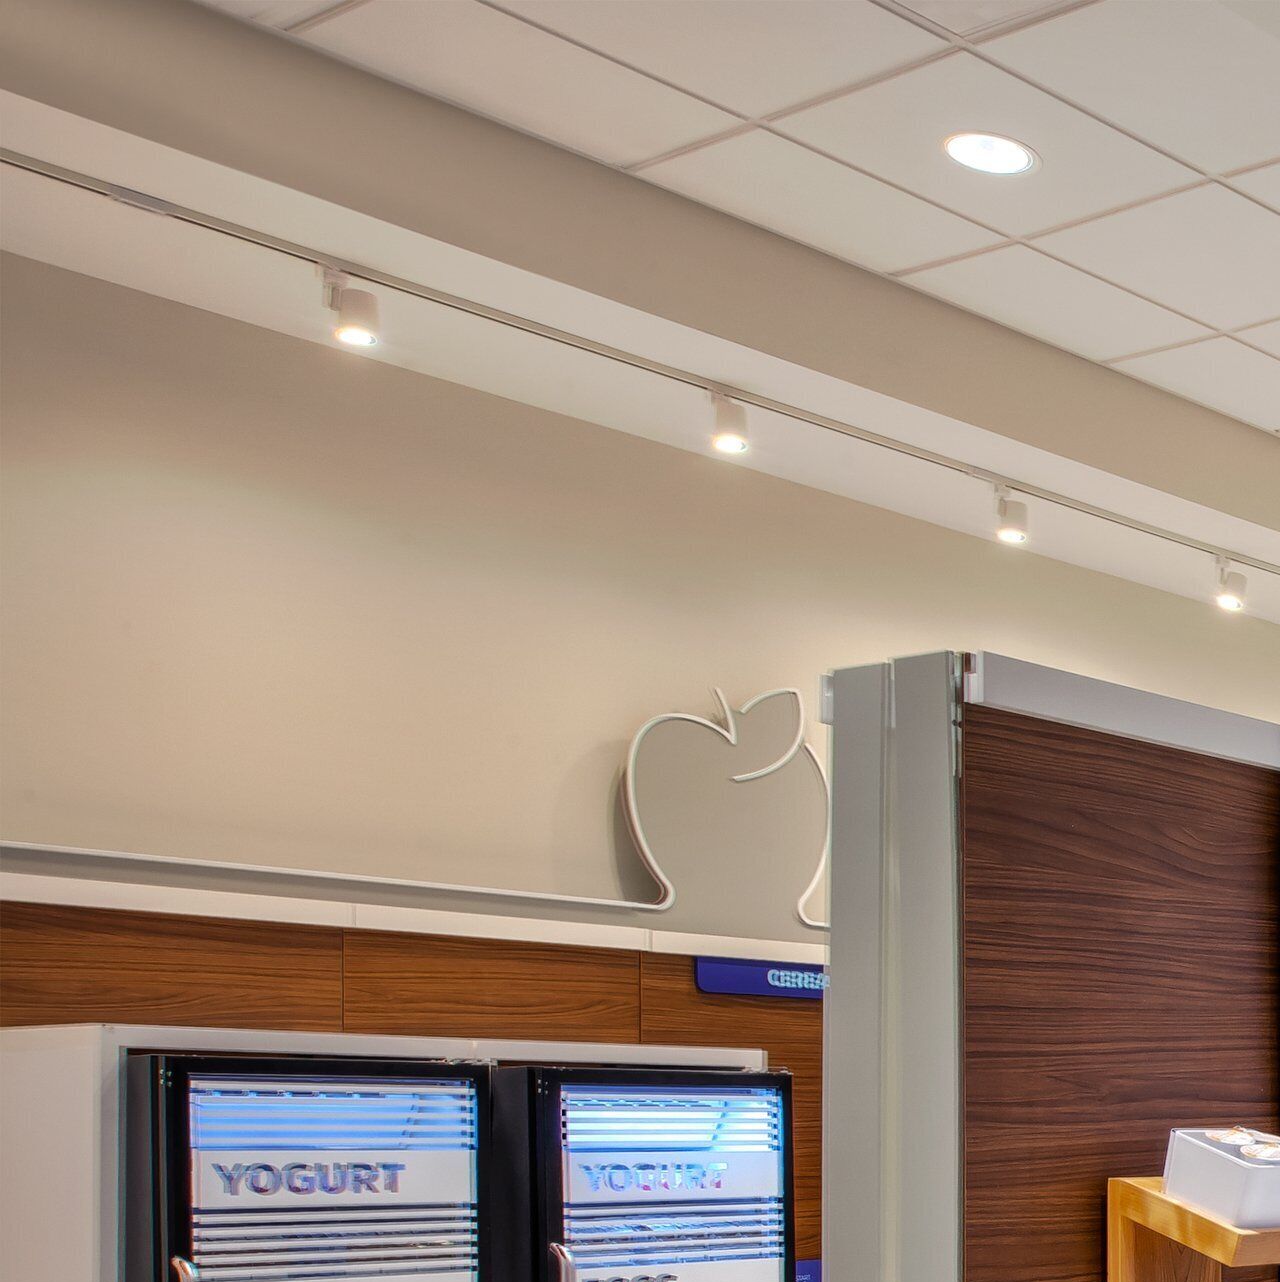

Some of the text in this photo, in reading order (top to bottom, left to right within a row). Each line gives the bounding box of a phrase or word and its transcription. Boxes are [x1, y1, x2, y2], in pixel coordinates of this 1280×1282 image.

[767, 969, 830, 990] CEREA
[212, 1162, 407, 1196] YOGURT
[578, 1162, 728, 1192] YOGURT
